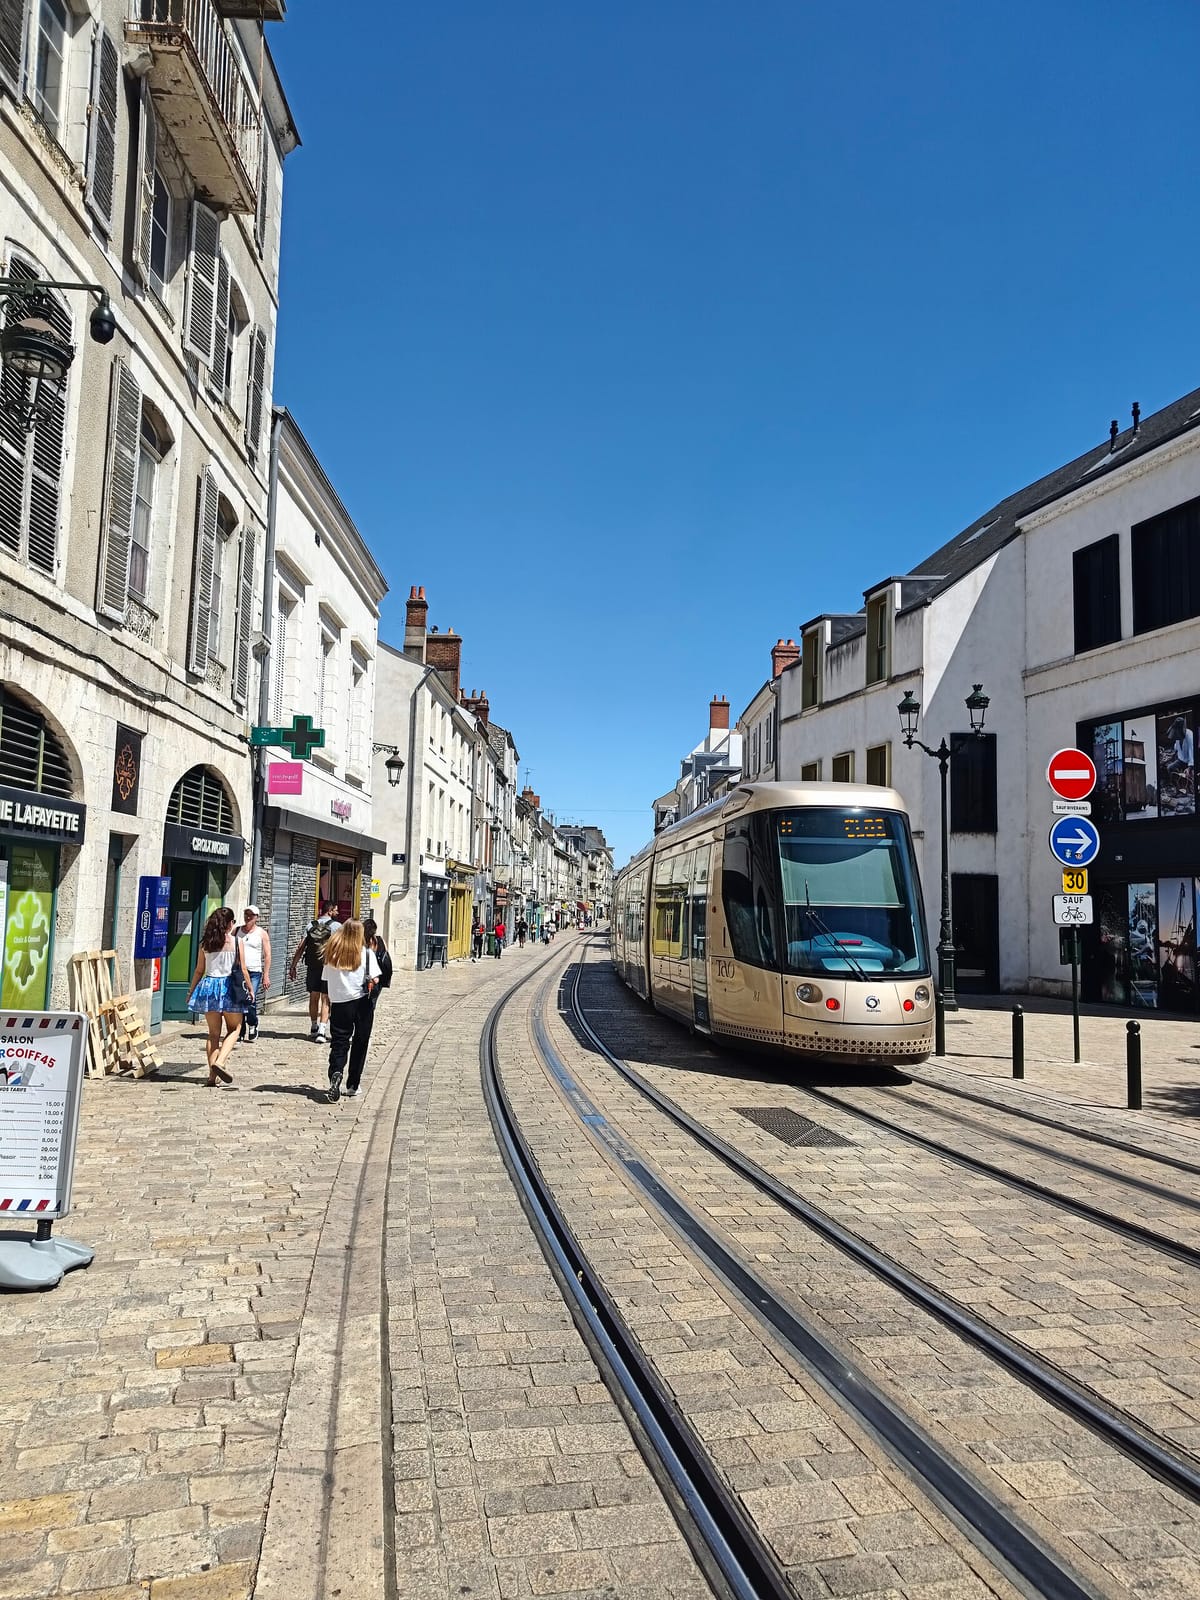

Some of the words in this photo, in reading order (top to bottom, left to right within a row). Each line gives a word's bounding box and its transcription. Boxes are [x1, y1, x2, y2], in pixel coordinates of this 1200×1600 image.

[14, 802, 80, 832] LAFAYETTE
[1066, 872, 1084, 889] 30
[1062, 896, 1084, 904] SAUF
[1, 1035, 34, 1044] SALON
